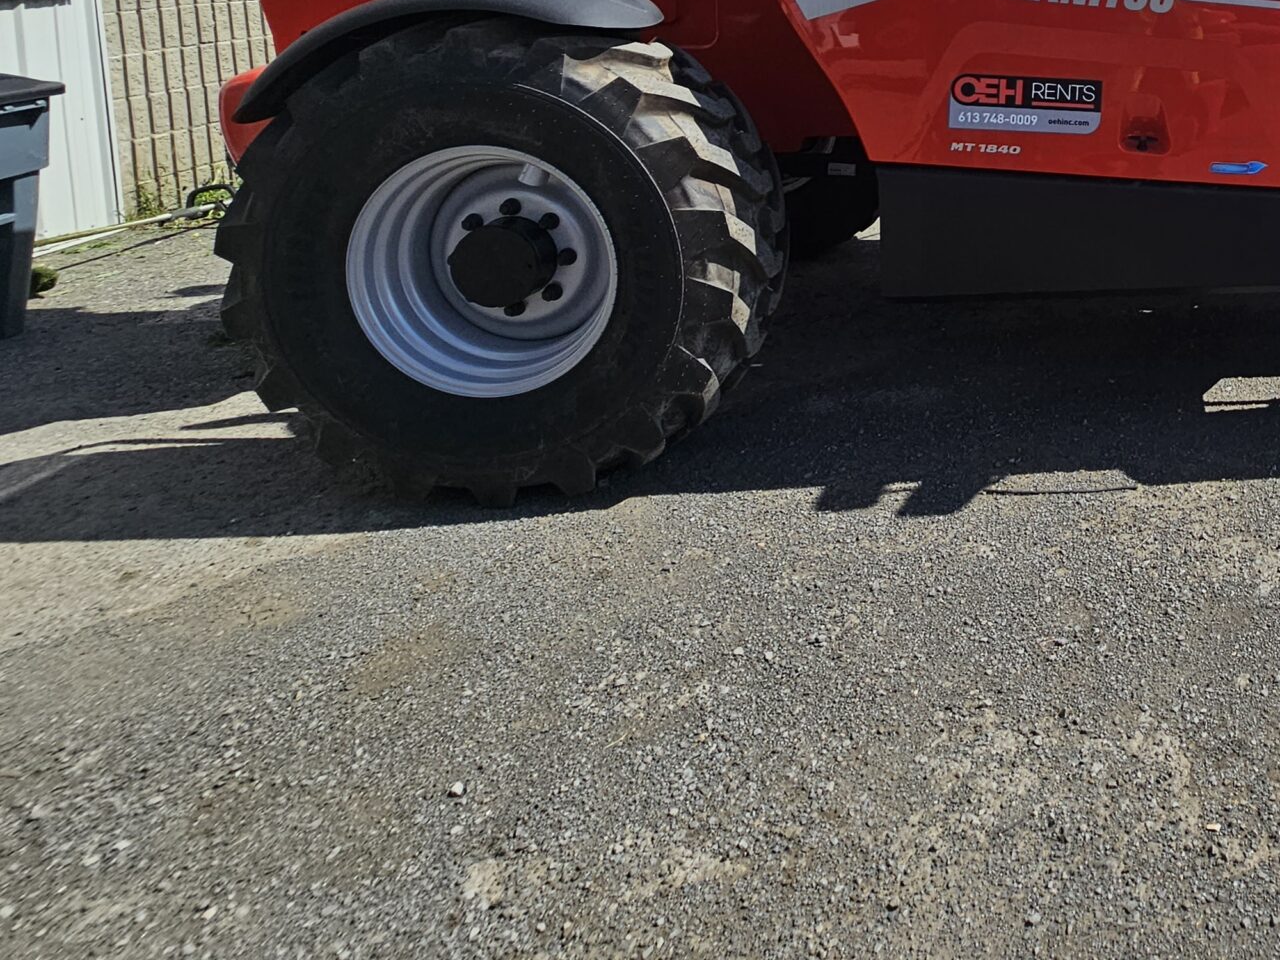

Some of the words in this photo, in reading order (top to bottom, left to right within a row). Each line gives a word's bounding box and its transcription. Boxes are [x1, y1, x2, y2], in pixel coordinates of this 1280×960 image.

[954, 76, 1024, 105] OEH
[1031, 82, 1096, 103] RENTS
[958, 111, 980, 123] 613
[983, 112, 1038, 125] 748-0009
[1047, 118, 1090, 127] oehinc.com
[950, 142, 975, 153] MT
[978, 143, 1021, 155] 1840
